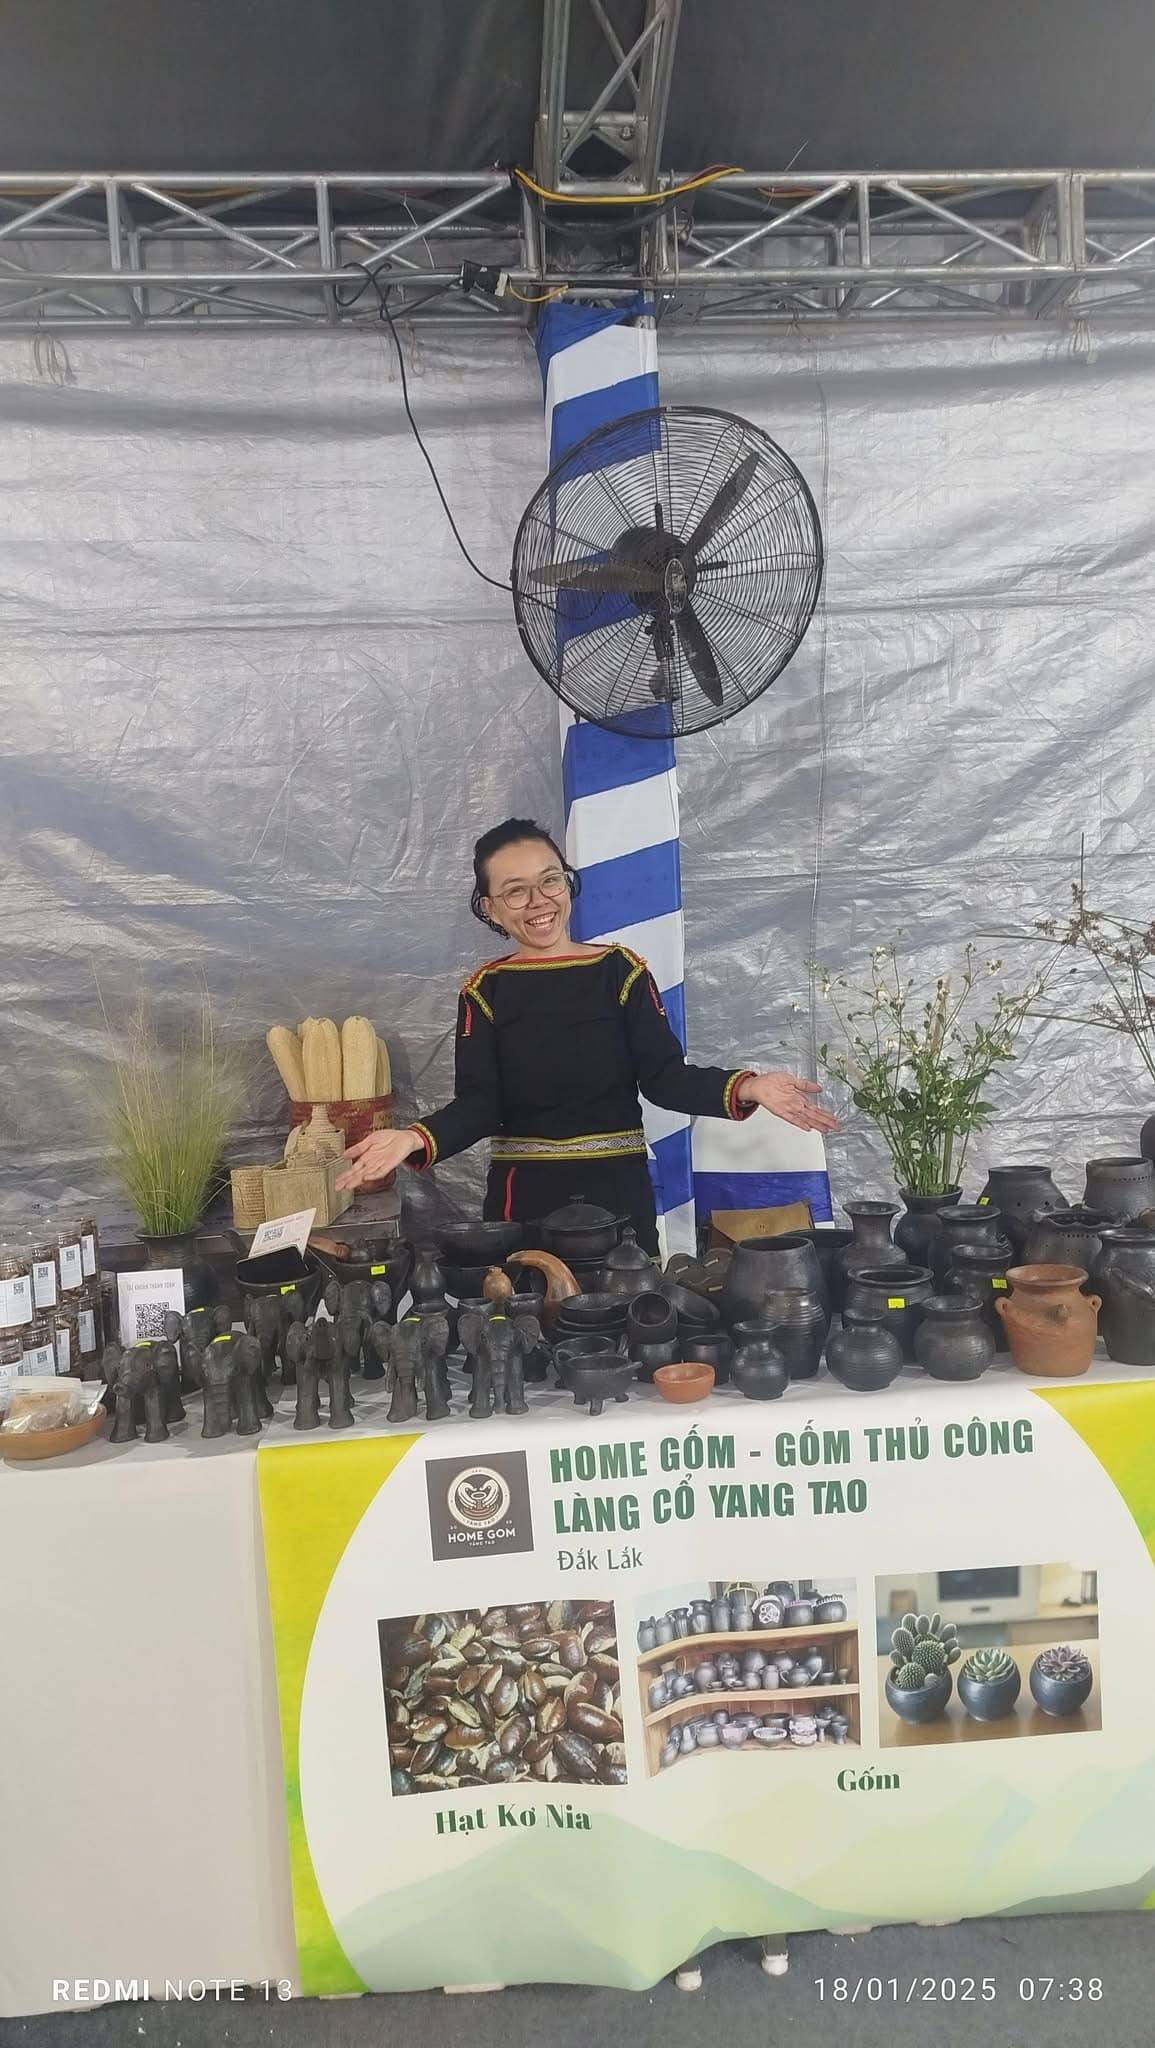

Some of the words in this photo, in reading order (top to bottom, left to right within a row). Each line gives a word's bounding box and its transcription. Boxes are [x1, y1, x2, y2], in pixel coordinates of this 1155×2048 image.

[549, 1441, 648, 1483] HOME
[659, 1424, 736, 1472] GỐM
[775, 1419, 850, 1467] GỐM
[863, 1416, 930, 1462] THỦ
[943, 1416, 1034, 1458] CÔNG
[553, 1492, 641, 1534] LÀNG
[653, 1473, 695, 1524] CỔ
[708, 1482, 795, 1518] YANG
[807, 1478, 868, 1515] TAO
[448, 1531, 484, 1543] HOME
[487, 1528, 516, 1539] GOM
[557, 1549, 600, 1571] Đắk
[607, 1547, 643, 1570] Lắk
[837, 1766, 900, 1792] Gốm
[434, 1808, 488, 1836] Hạt
[497, 1803, 537, 1828] Kơ
[546, 1804, 593, 1830] Nia
